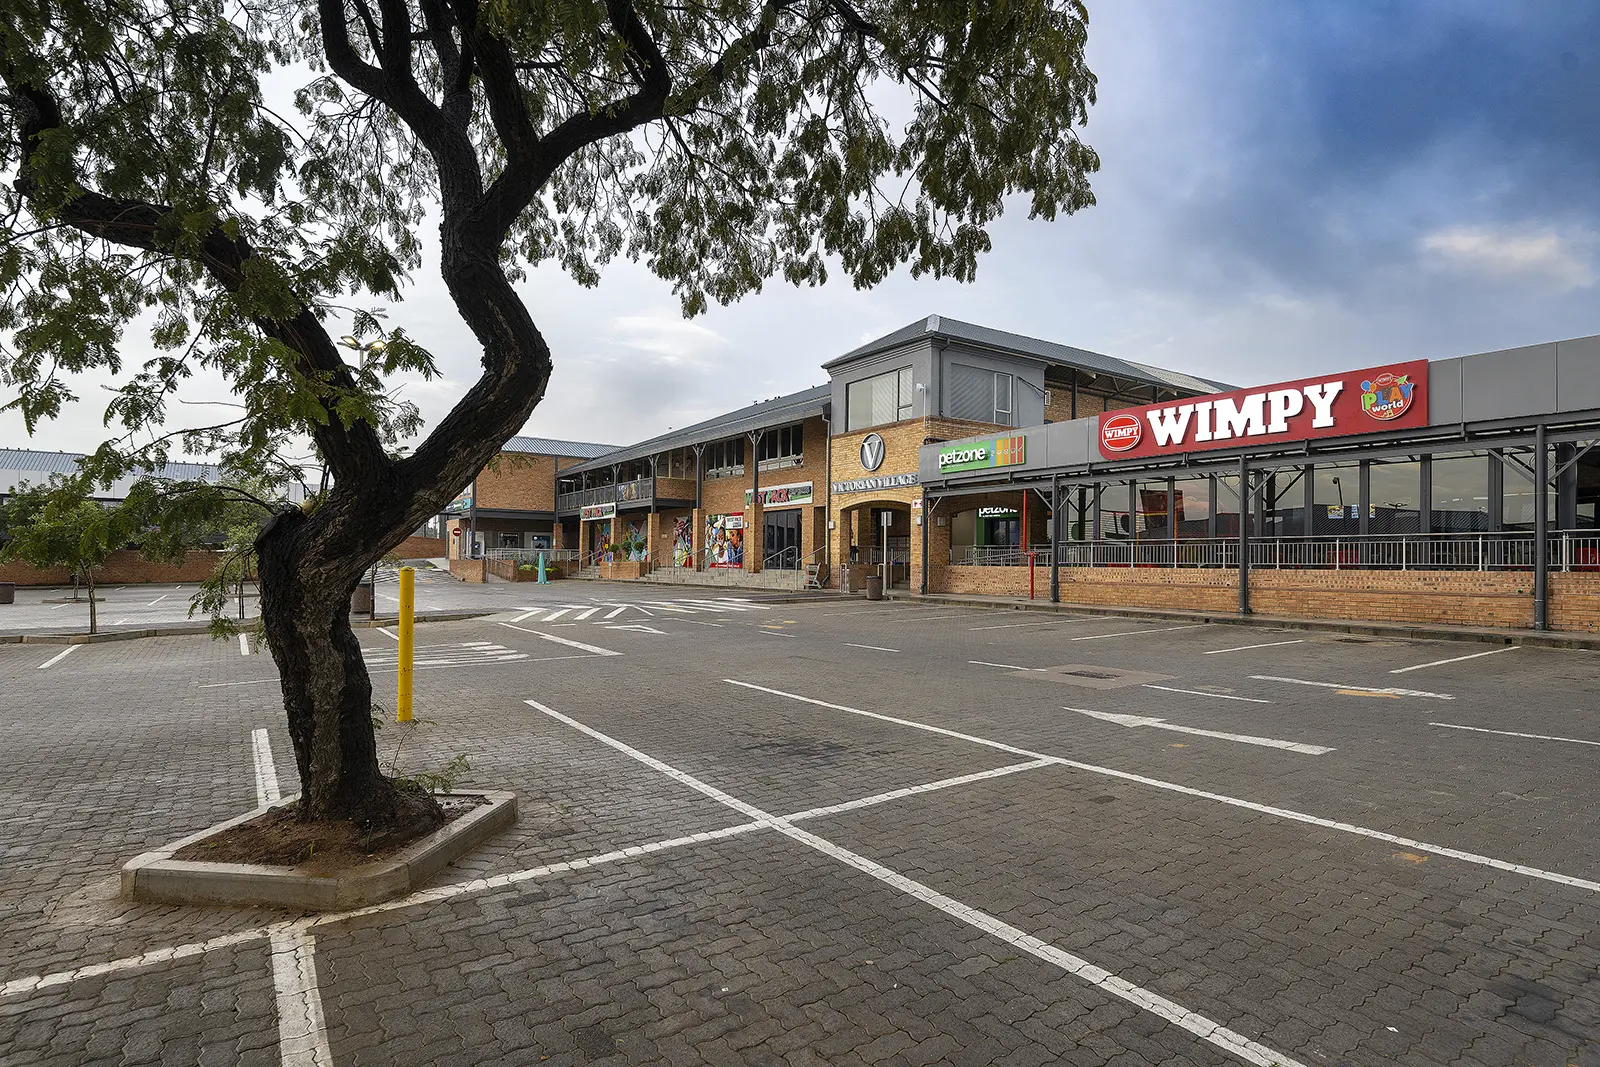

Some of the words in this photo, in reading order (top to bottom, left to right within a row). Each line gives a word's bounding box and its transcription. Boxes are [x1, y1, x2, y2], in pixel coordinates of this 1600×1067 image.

[1361, 383, 1414, 411] PLAY
[1372, 400, 1404, 412] world
[1146, 381, 1344, 447] WIMPY
[1105, 427, 1138, 438] WIMPY
[861, 441, 881, 469] V
[939, 447, 986, 469] petzone
[767, 488, 789, 503] PACK
